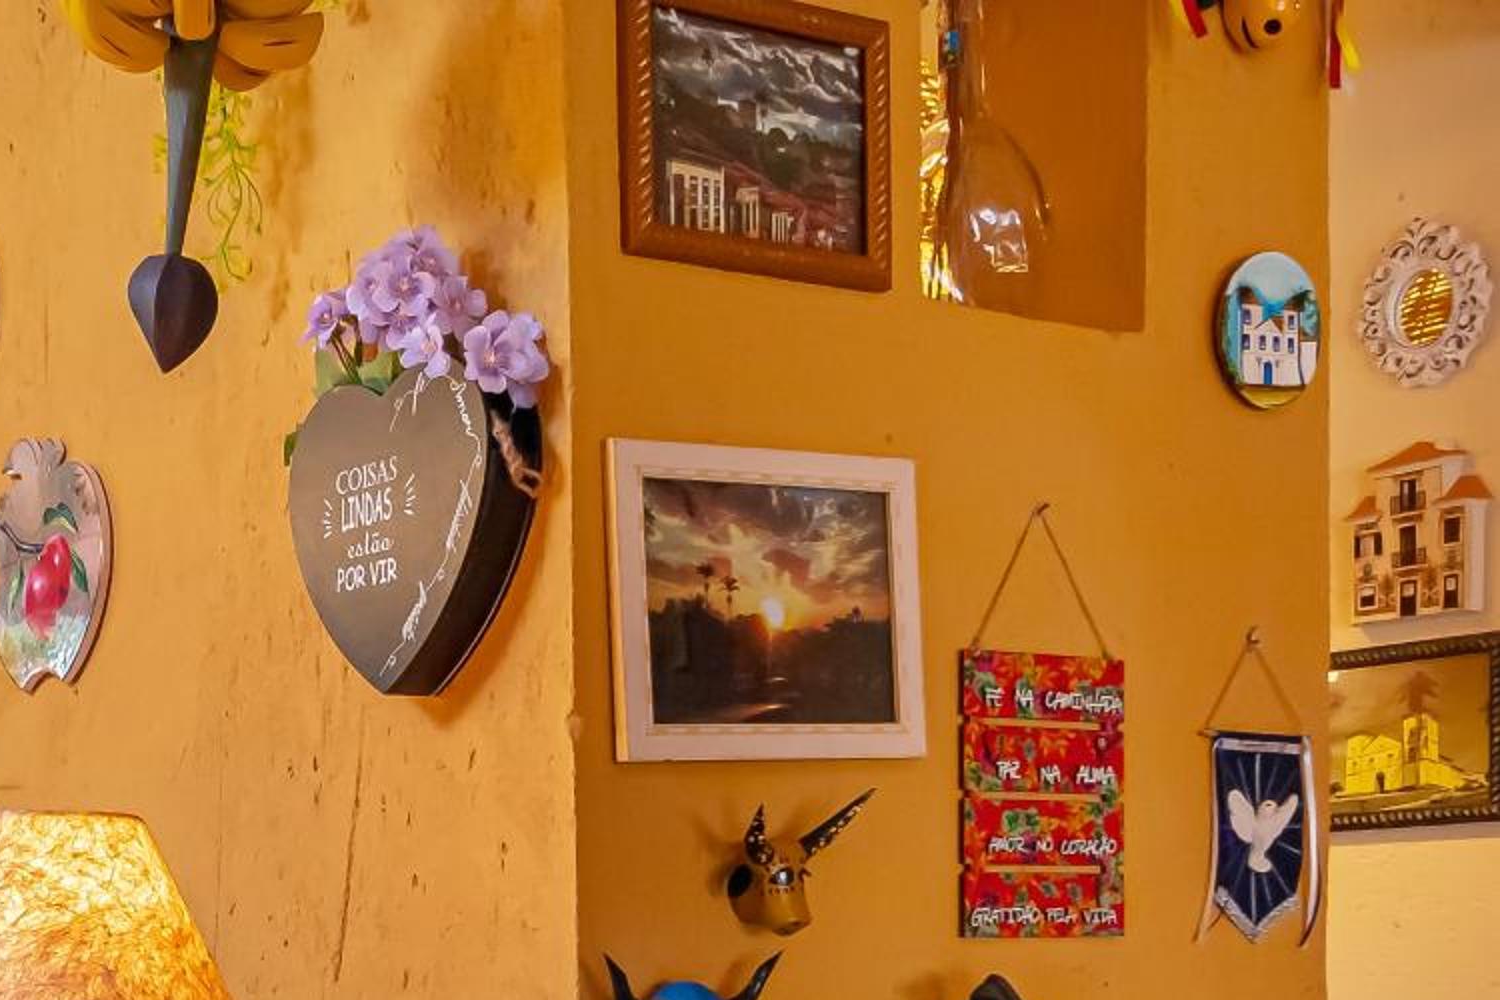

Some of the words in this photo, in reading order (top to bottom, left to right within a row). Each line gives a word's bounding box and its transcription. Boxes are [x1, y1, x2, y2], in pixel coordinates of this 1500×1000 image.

[335, 456, 397, 495] COISAS
[341, 487, 393, 532] LINDAS
[347, 530, 390, 559] estão
[337, 563, 366, 593] POR
[369, 557, 398, 586] VIR
[1015, 688, 1034, 710] NA
[1040, 764, 1062, 785] NA
[1076, 764, 1116, 785] ALMA
[1035, 834, 1053, 853] NO
[1083, 907, 1117, 925] VIDA
